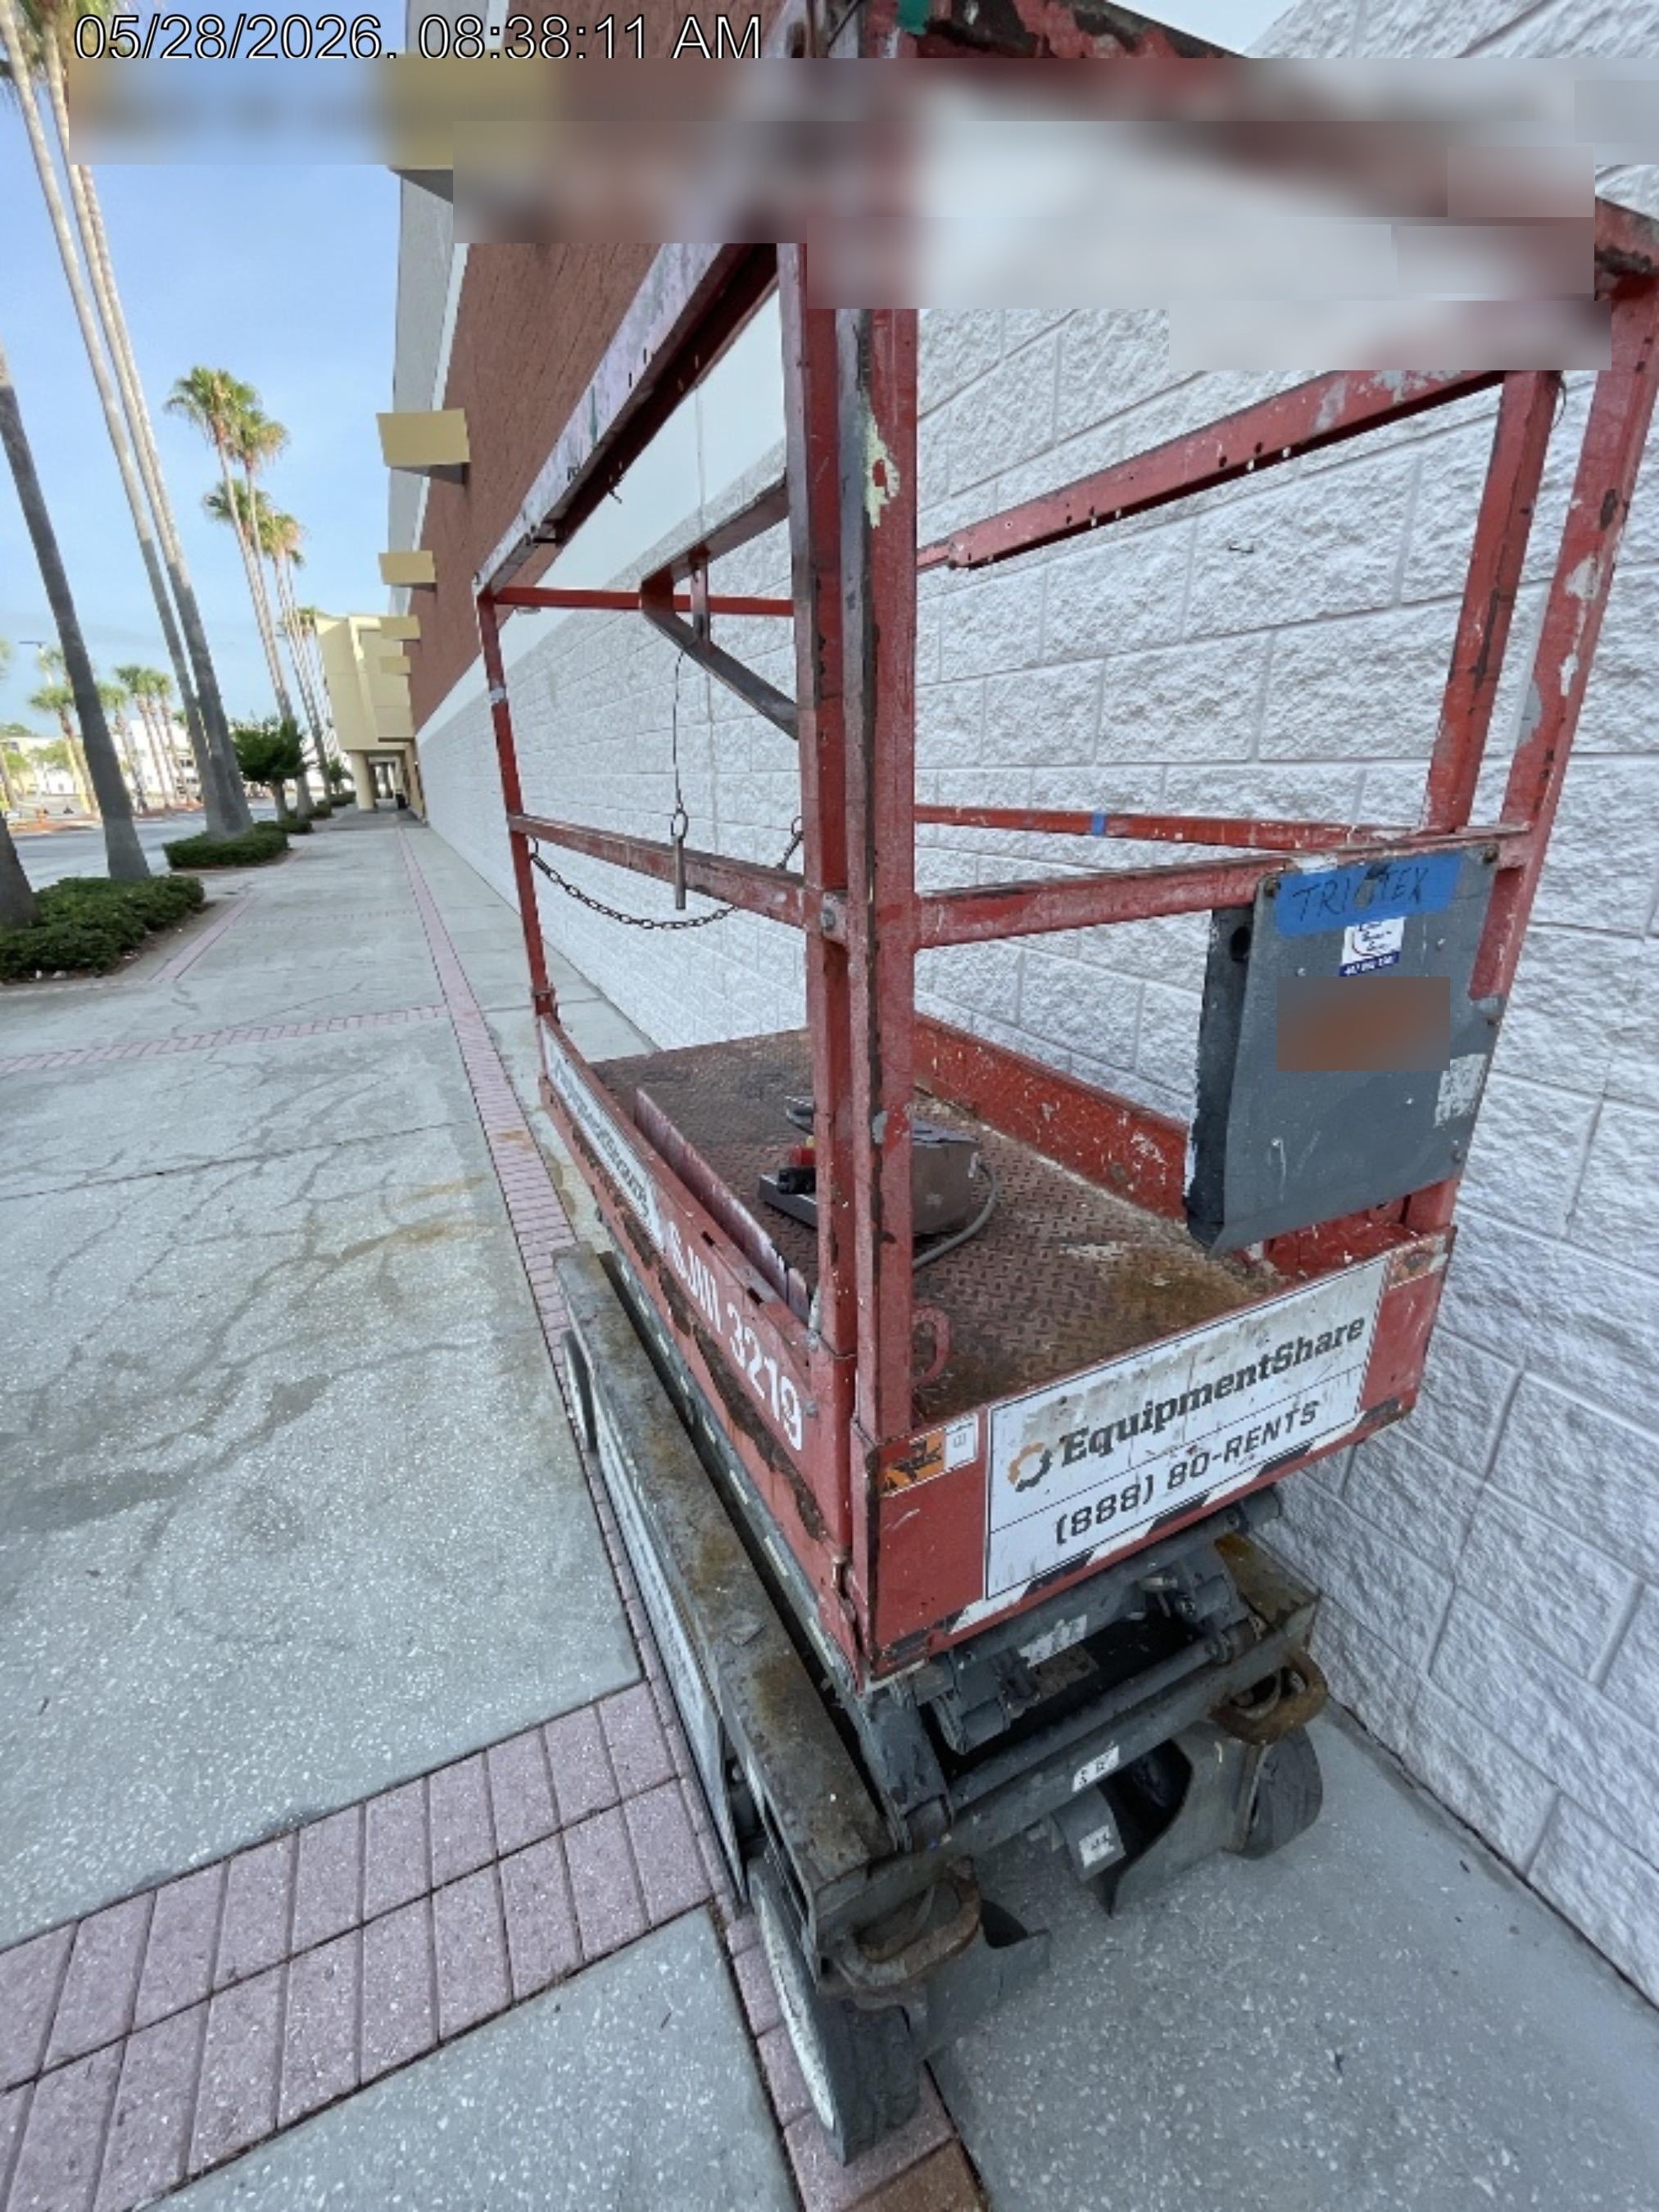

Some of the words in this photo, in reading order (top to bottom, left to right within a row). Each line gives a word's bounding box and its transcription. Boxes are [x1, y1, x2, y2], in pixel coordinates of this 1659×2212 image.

[727, 1302, 802, 1451] 3219
[1059, 1317, 1366, 1467] EquipmentShare
[1055, 1475, 1154, 1546] (888)
[1167, 1399, 1320, 1491] 80-RENTS
